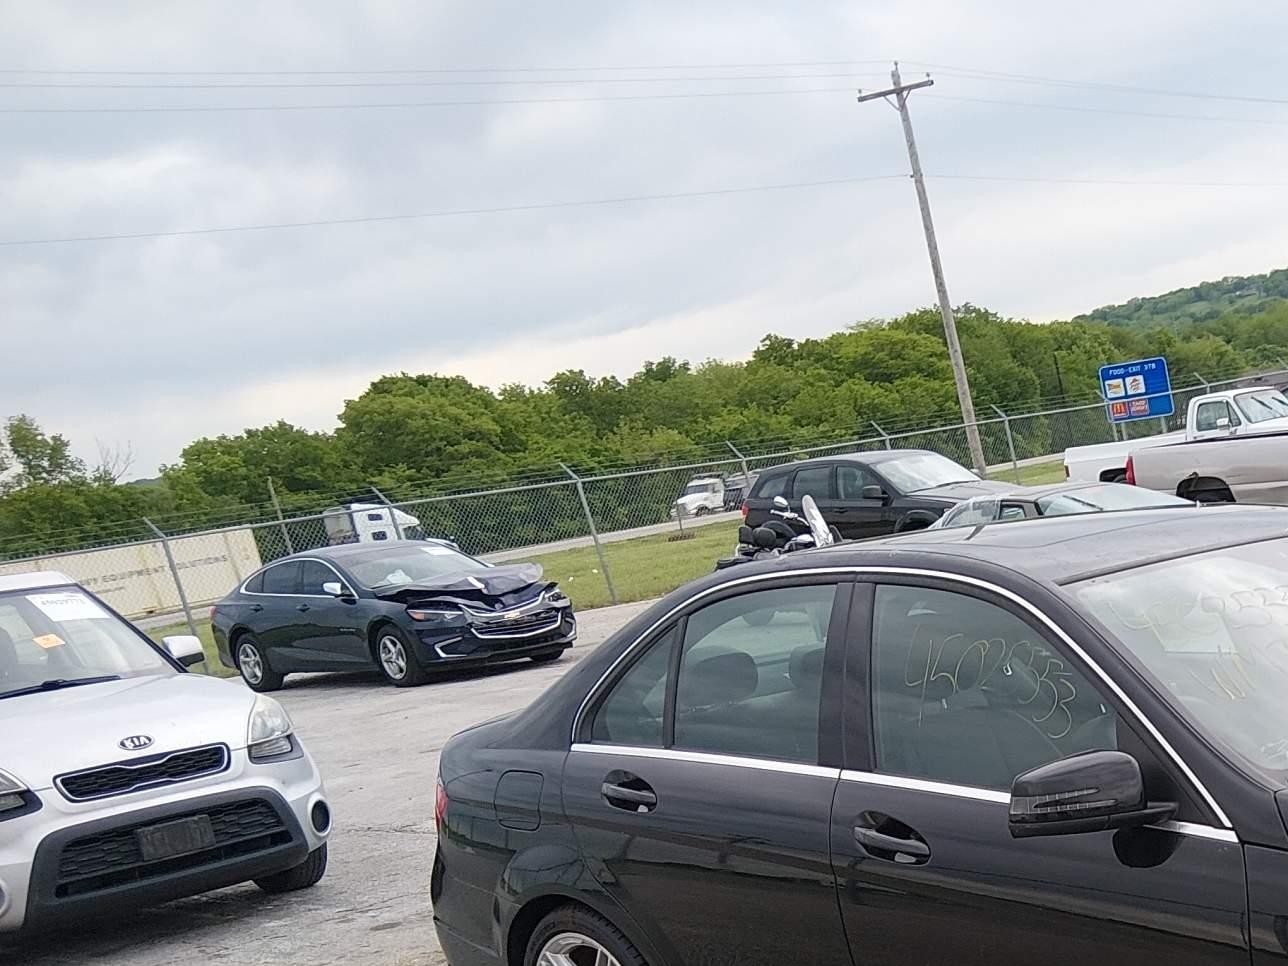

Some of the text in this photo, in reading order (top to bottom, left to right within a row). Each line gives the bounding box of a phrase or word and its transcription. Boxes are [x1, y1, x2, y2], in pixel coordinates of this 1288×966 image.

[102, 565, 166, 583] EQUIPMENT
[174, 554, 228, 570] OLUTIONS
[121, 736, 152, 750] KIA
